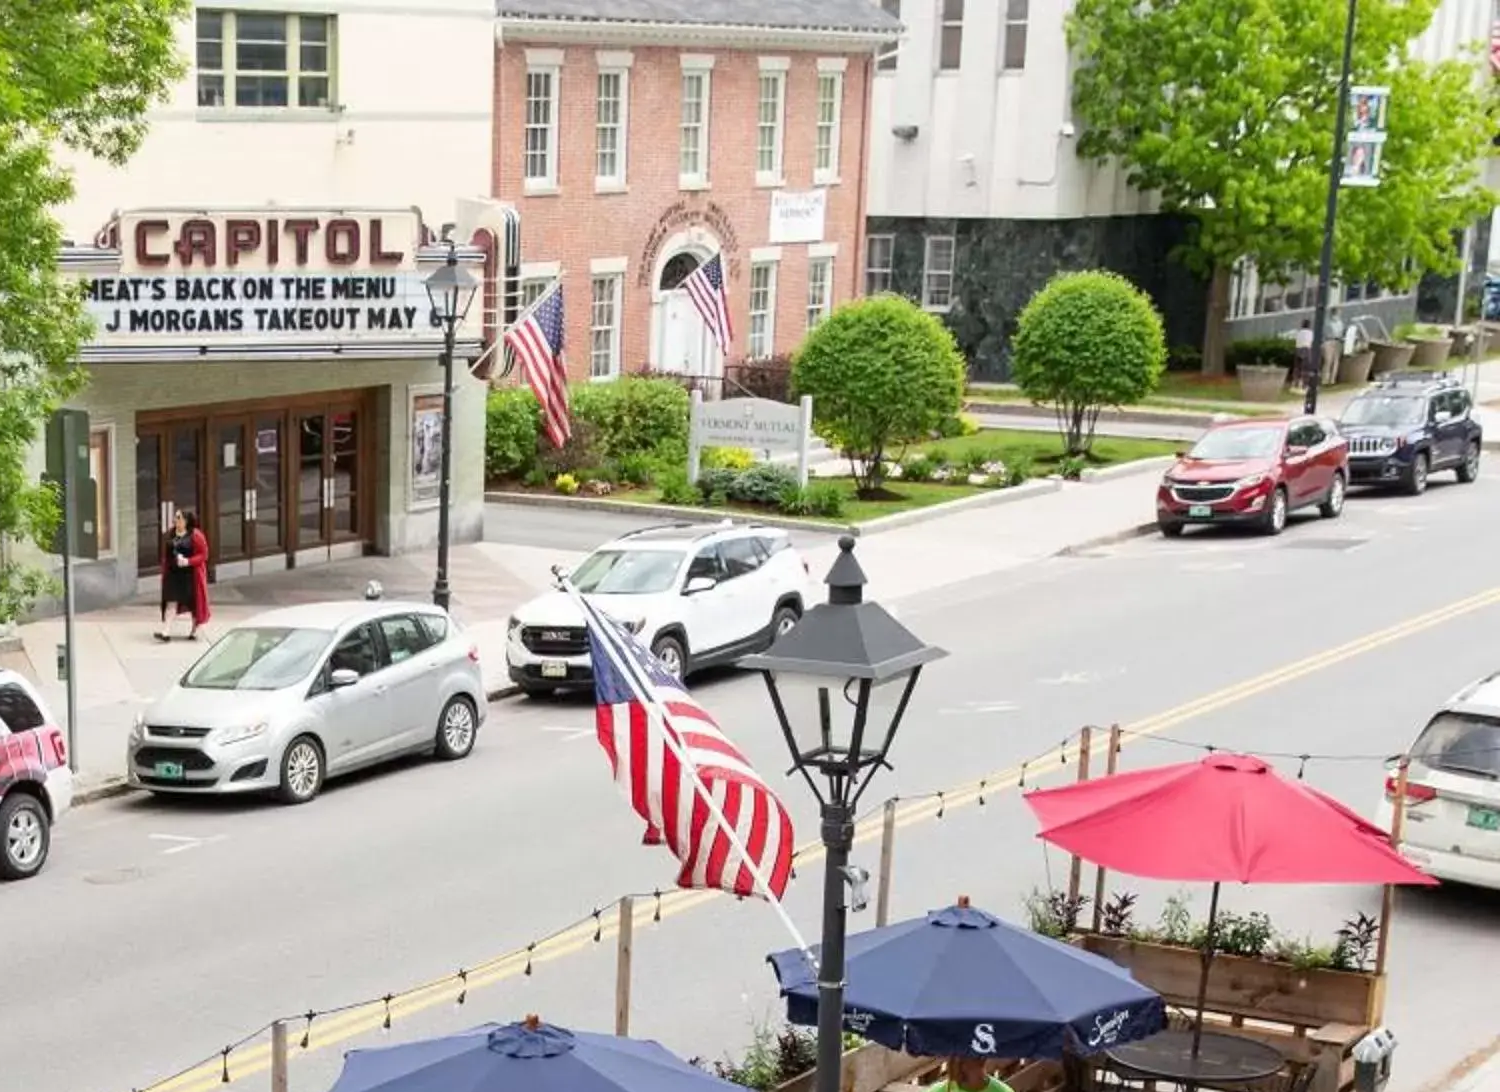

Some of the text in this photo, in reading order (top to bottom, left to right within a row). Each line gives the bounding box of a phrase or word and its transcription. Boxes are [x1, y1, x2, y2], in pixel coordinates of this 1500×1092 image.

[135, 217, 404, 267] CAPITOL
[80, 275, 396, 301] MEAT'S BACK ON THE MENU
[105, 309, 121, 332] J
[129, 308, 243, 333] MORGANS
[254, 307, 360, 331] TAKEOUT
[367, 307, 417, 330] MAY
